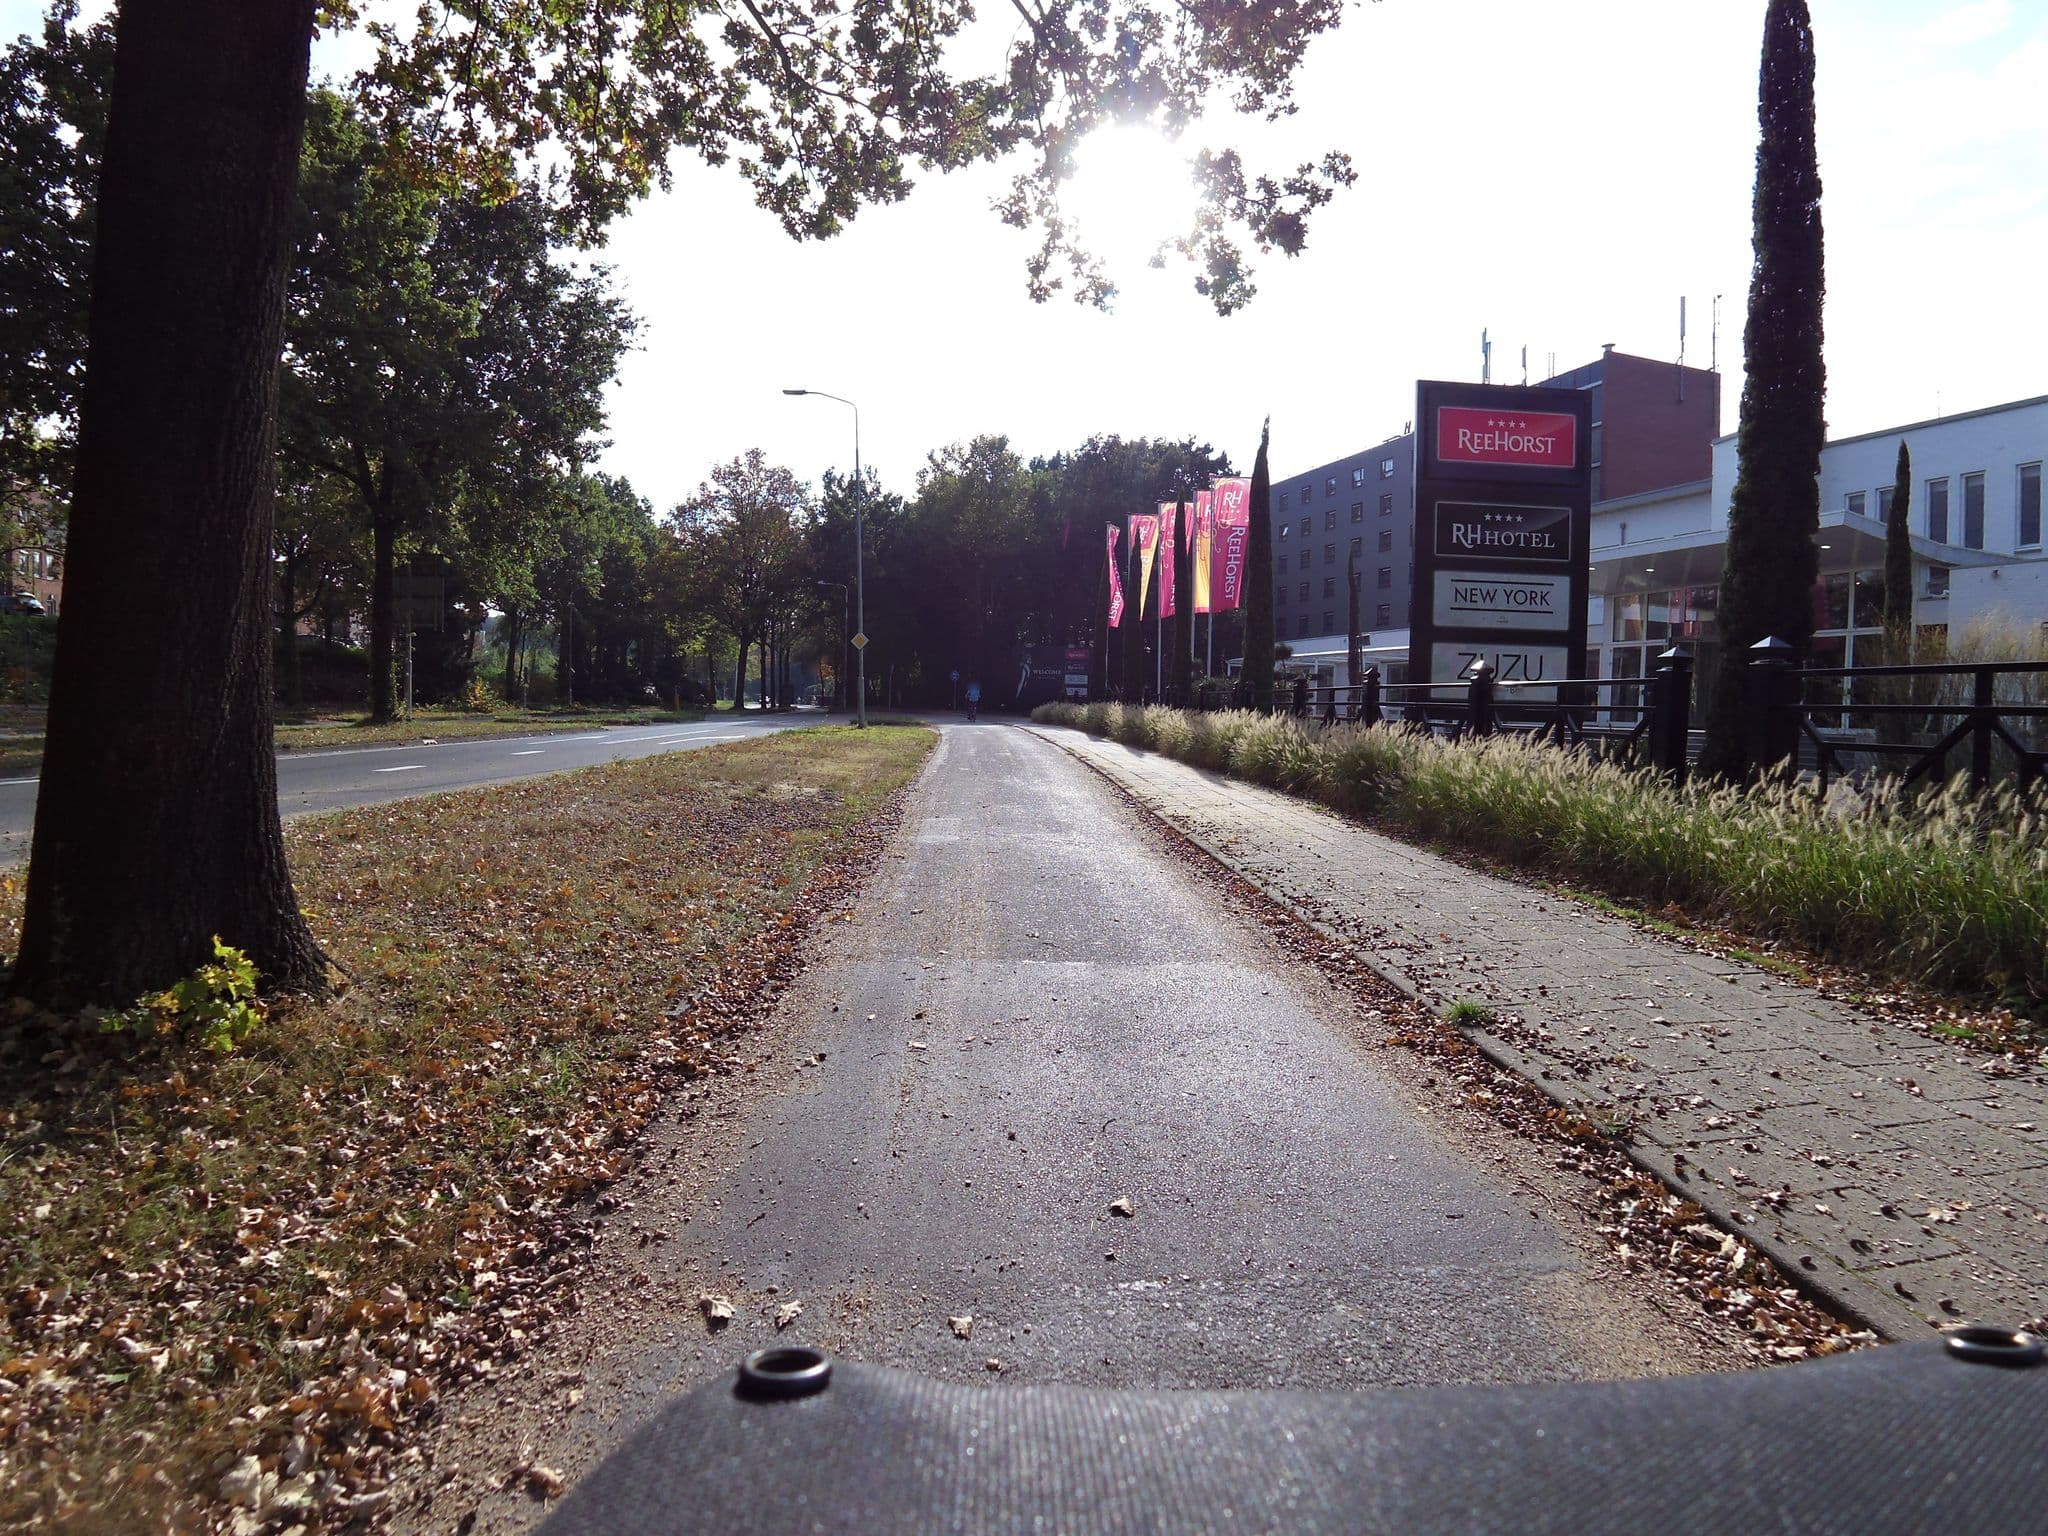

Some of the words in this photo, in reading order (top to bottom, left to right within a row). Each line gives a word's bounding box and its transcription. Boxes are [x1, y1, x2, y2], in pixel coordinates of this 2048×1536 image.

[1223, 490, 1243, 508] RH
[1454, 587, 1498, 605] NEW
[1503, 589, 1551, 607] YORK
[1456, 652, 1543, 682] ZUZU
